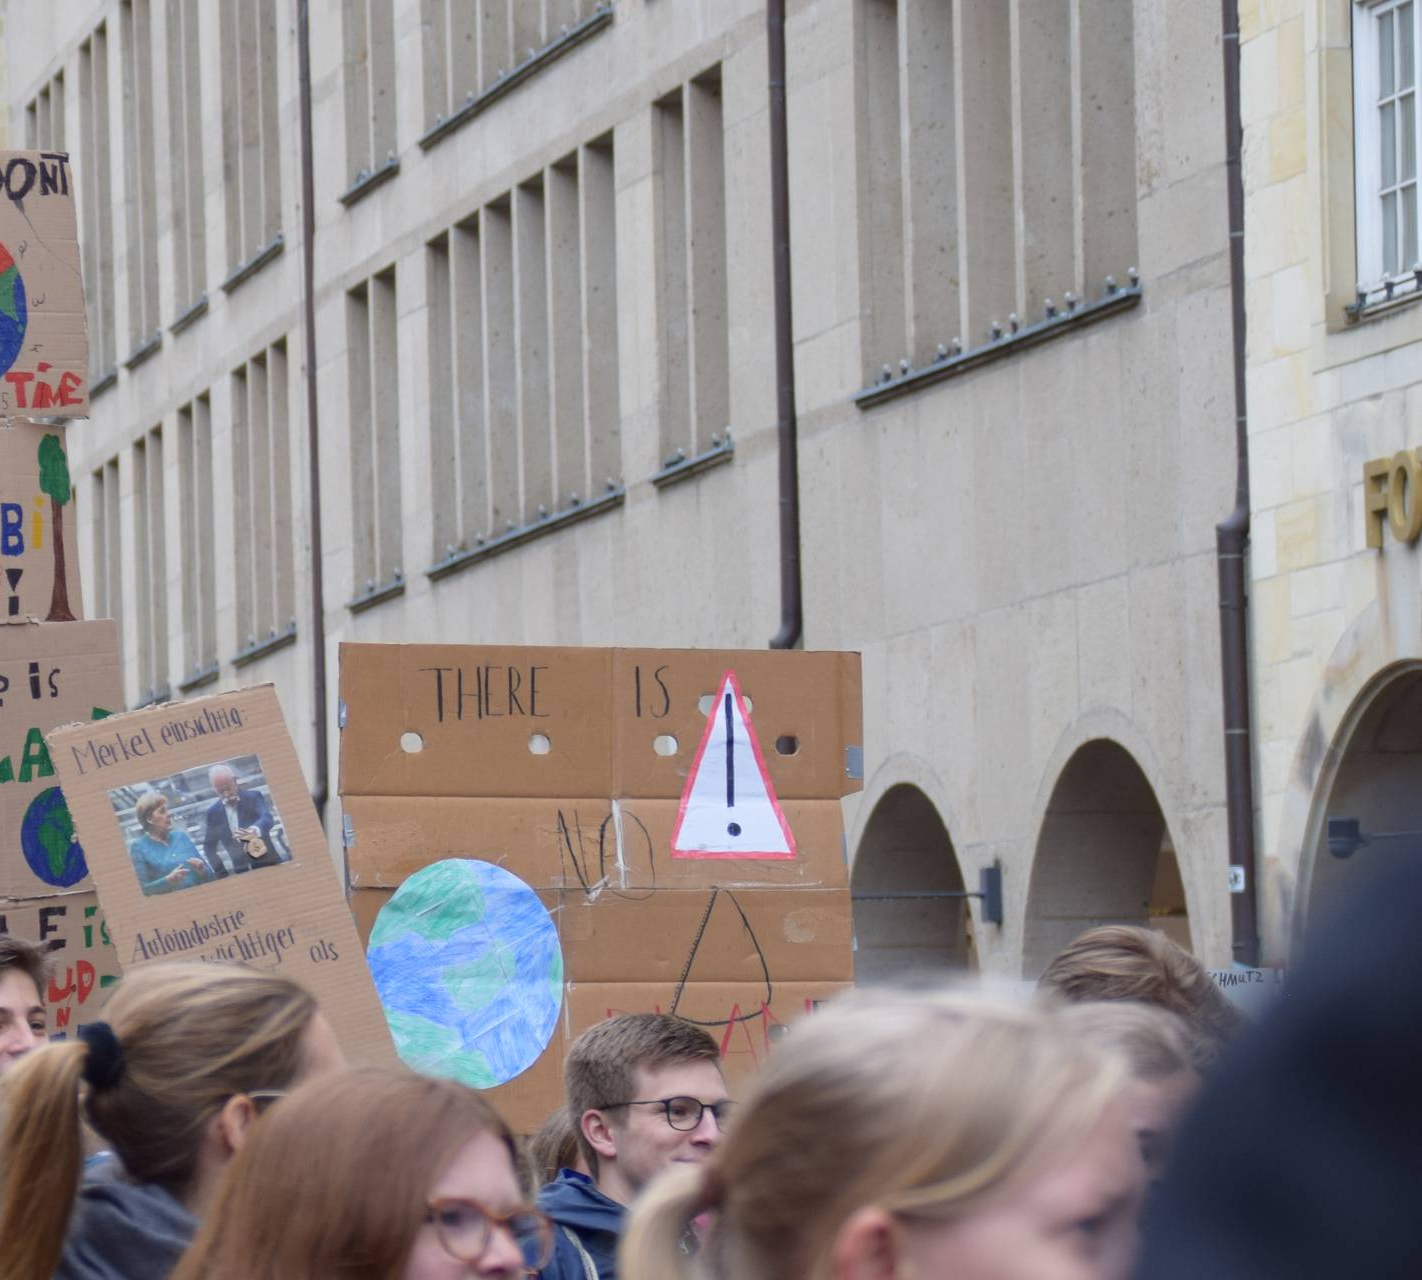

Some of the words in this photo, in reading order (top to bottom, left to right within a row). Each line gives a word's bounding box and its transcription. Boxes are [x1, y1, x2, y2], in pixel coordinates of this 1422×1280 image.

[1363, 446, 1422, 550] FO
[28, 661, 61, 700] is
[419, 665, 550, 723] THERE
[633, 665, 671, 719] IS
[71, 728, 156, 775] Merkel
[131, 909, 245, 963] Autoindustrie
[310, 938, 339, 964] als
